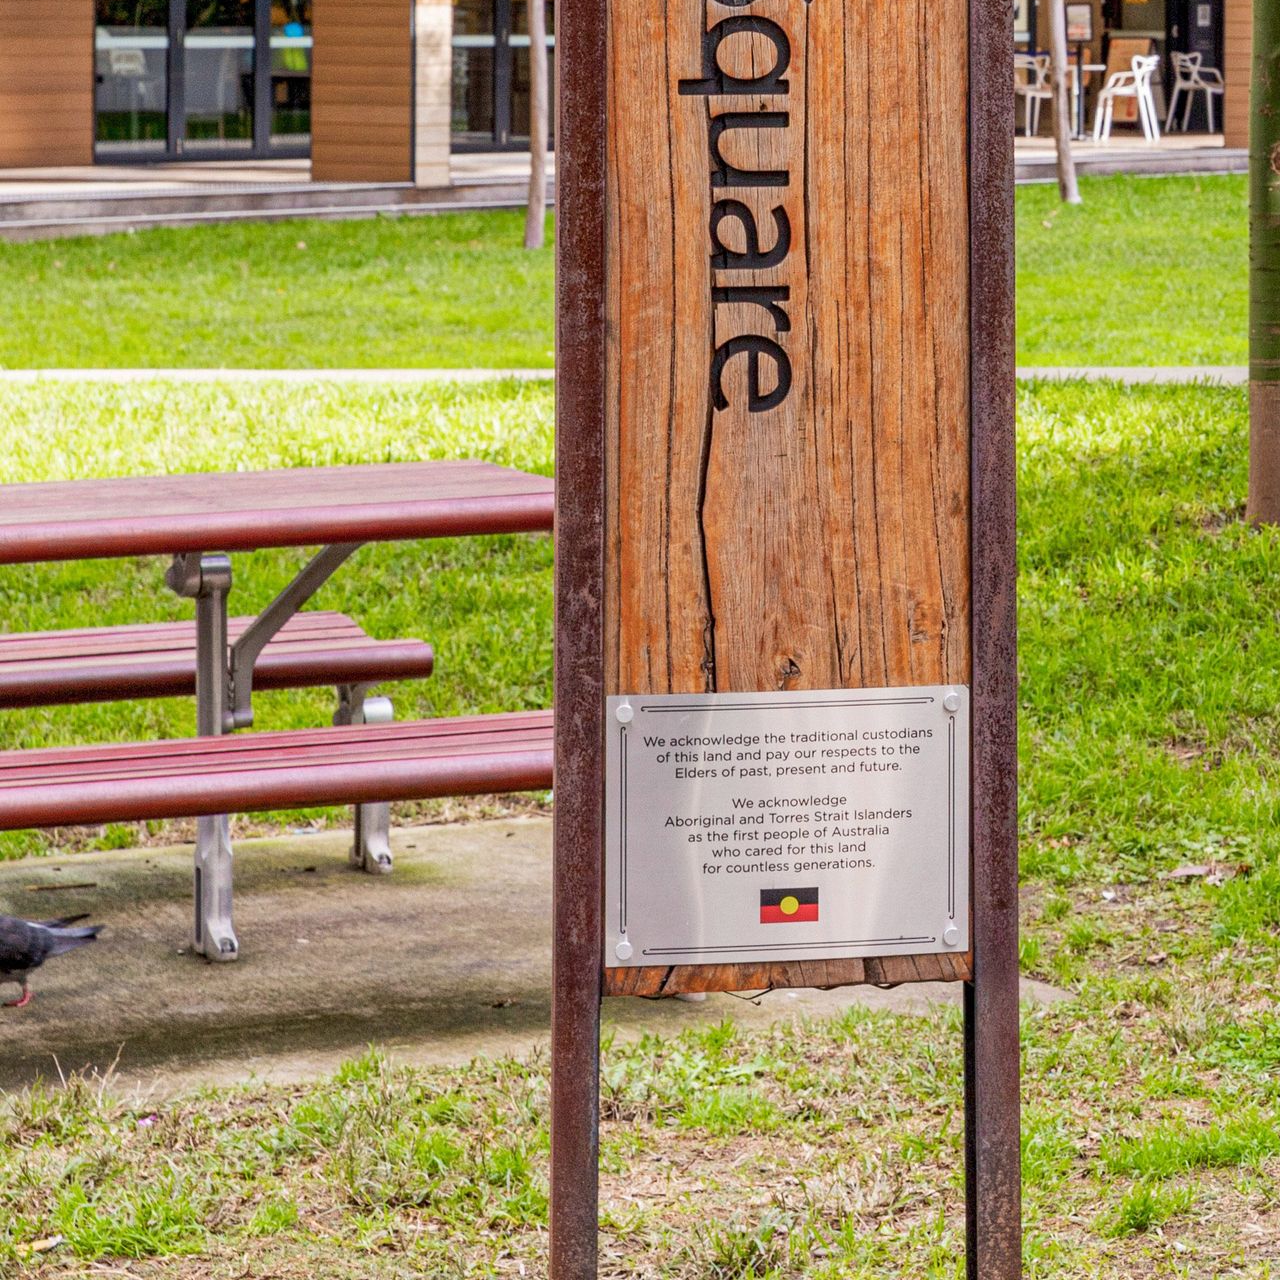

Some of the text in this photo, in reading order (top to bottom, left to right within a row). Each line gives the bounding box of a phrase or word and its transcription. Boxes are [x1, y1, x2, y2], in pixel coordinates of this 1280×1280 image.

[642, 727, 934, 749] We acknowledge the traditional custodians
[655, 742, 921, 764] of this land and pay our respects to the
[674, 759, 903, 780] Elders of past, present and future.
[731, 793, 848, 810] We acknowledge
[663, 807, 913, 830] Aboriginal and Torres Strait Islanders
[687, 823, 890, 844] as the first people of Australia
[711, 839, 867, 859] who cared for this land
[702, 857, 876, 875] for countless generations.
